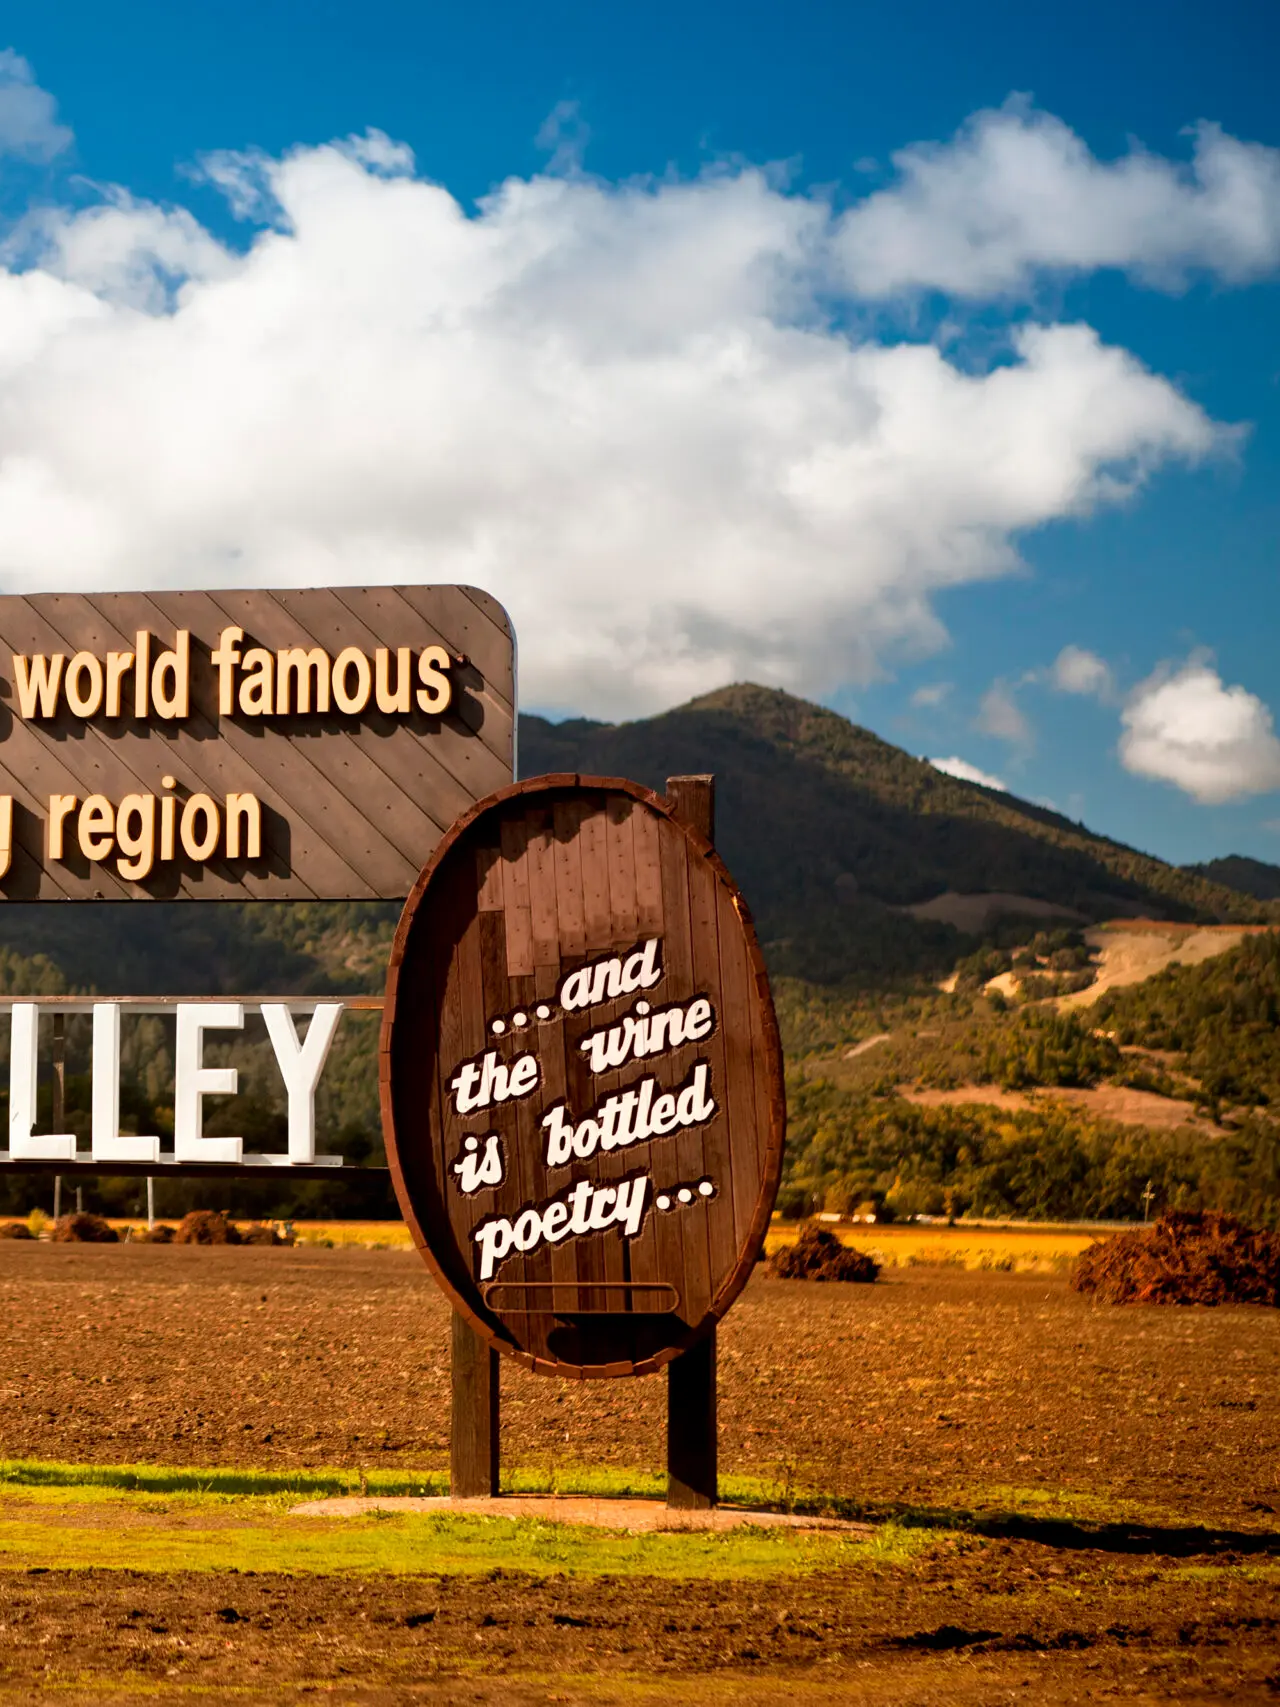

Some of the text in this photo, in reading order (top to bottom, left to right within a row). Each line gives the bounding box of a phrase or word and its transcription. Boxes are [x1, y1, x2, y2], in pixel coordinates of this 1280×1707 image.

[13, 629, 190, 720] world
[211, 626, 451, 716] famous
[49, 775, 261, 881] region
[451, 999, 713, 1114] the wine
[455, 1064, 715, 1193] is bottled
